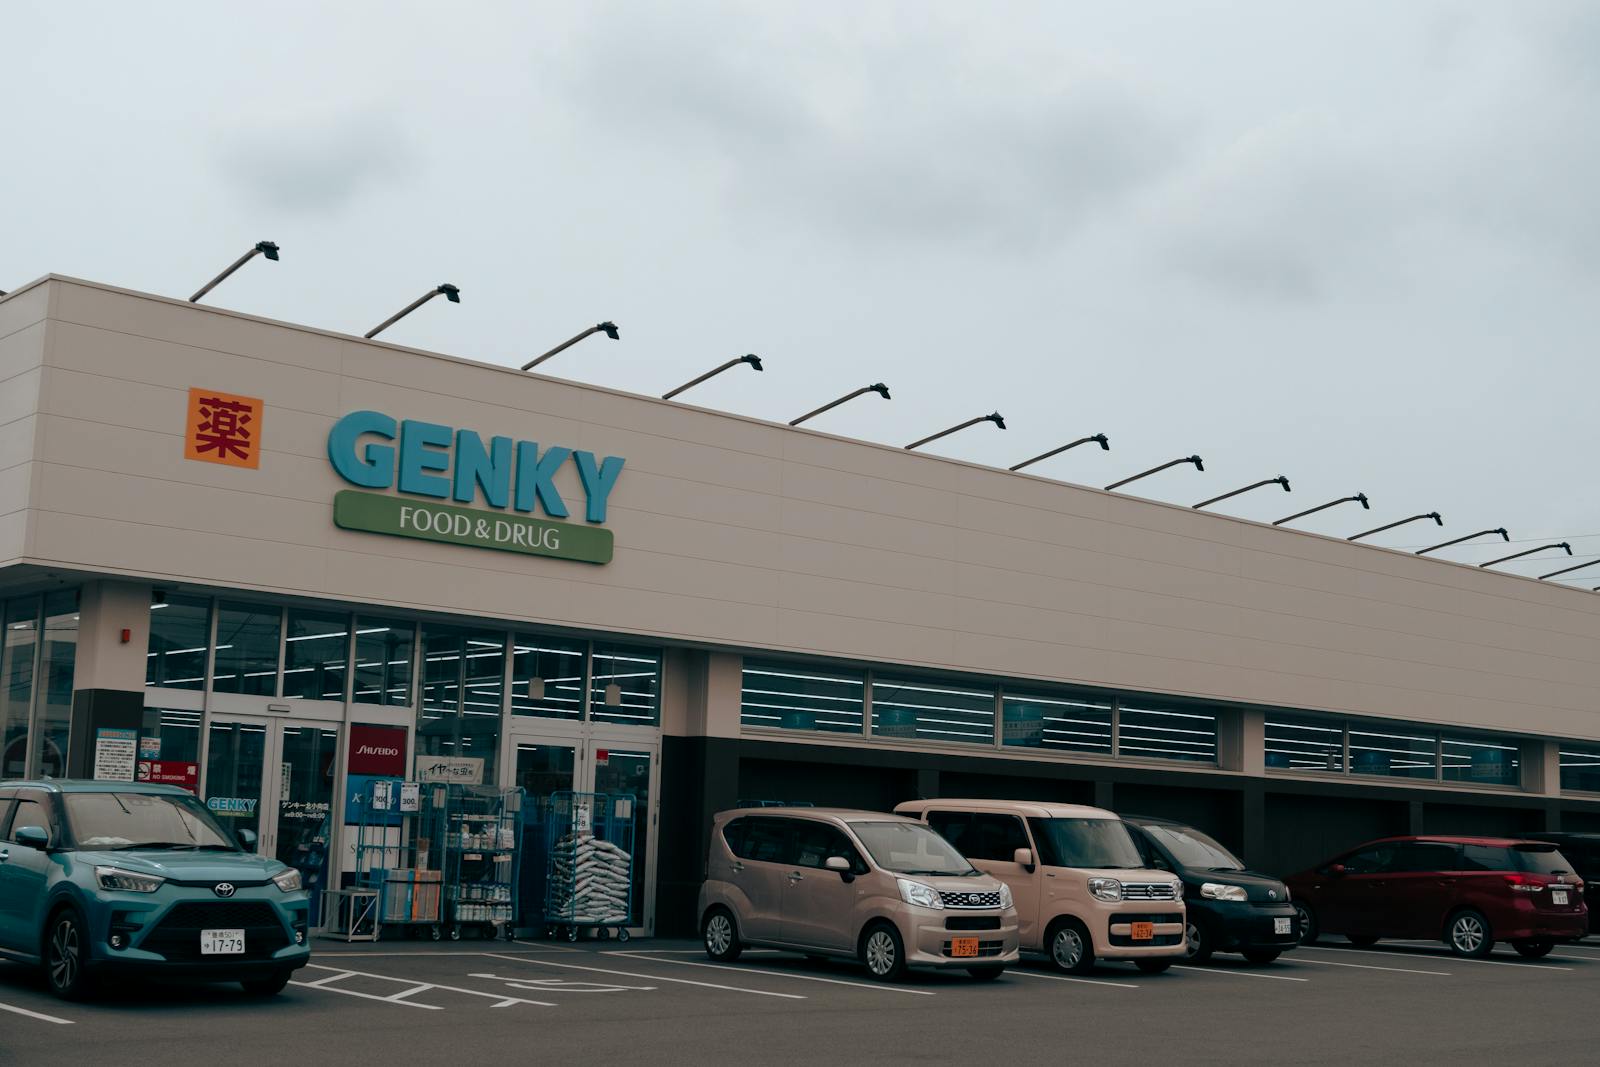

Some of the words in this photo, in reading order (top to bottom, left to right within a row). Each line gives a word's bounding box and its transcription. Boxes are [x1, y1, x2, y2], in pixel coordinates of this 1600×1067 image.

[196, 398, 253, 460] 薬
[328, 410, 625, 523] GENKY
[356, 745, 399, 756] SHISEIDO
[207, 797, 257, 812] GENKY
